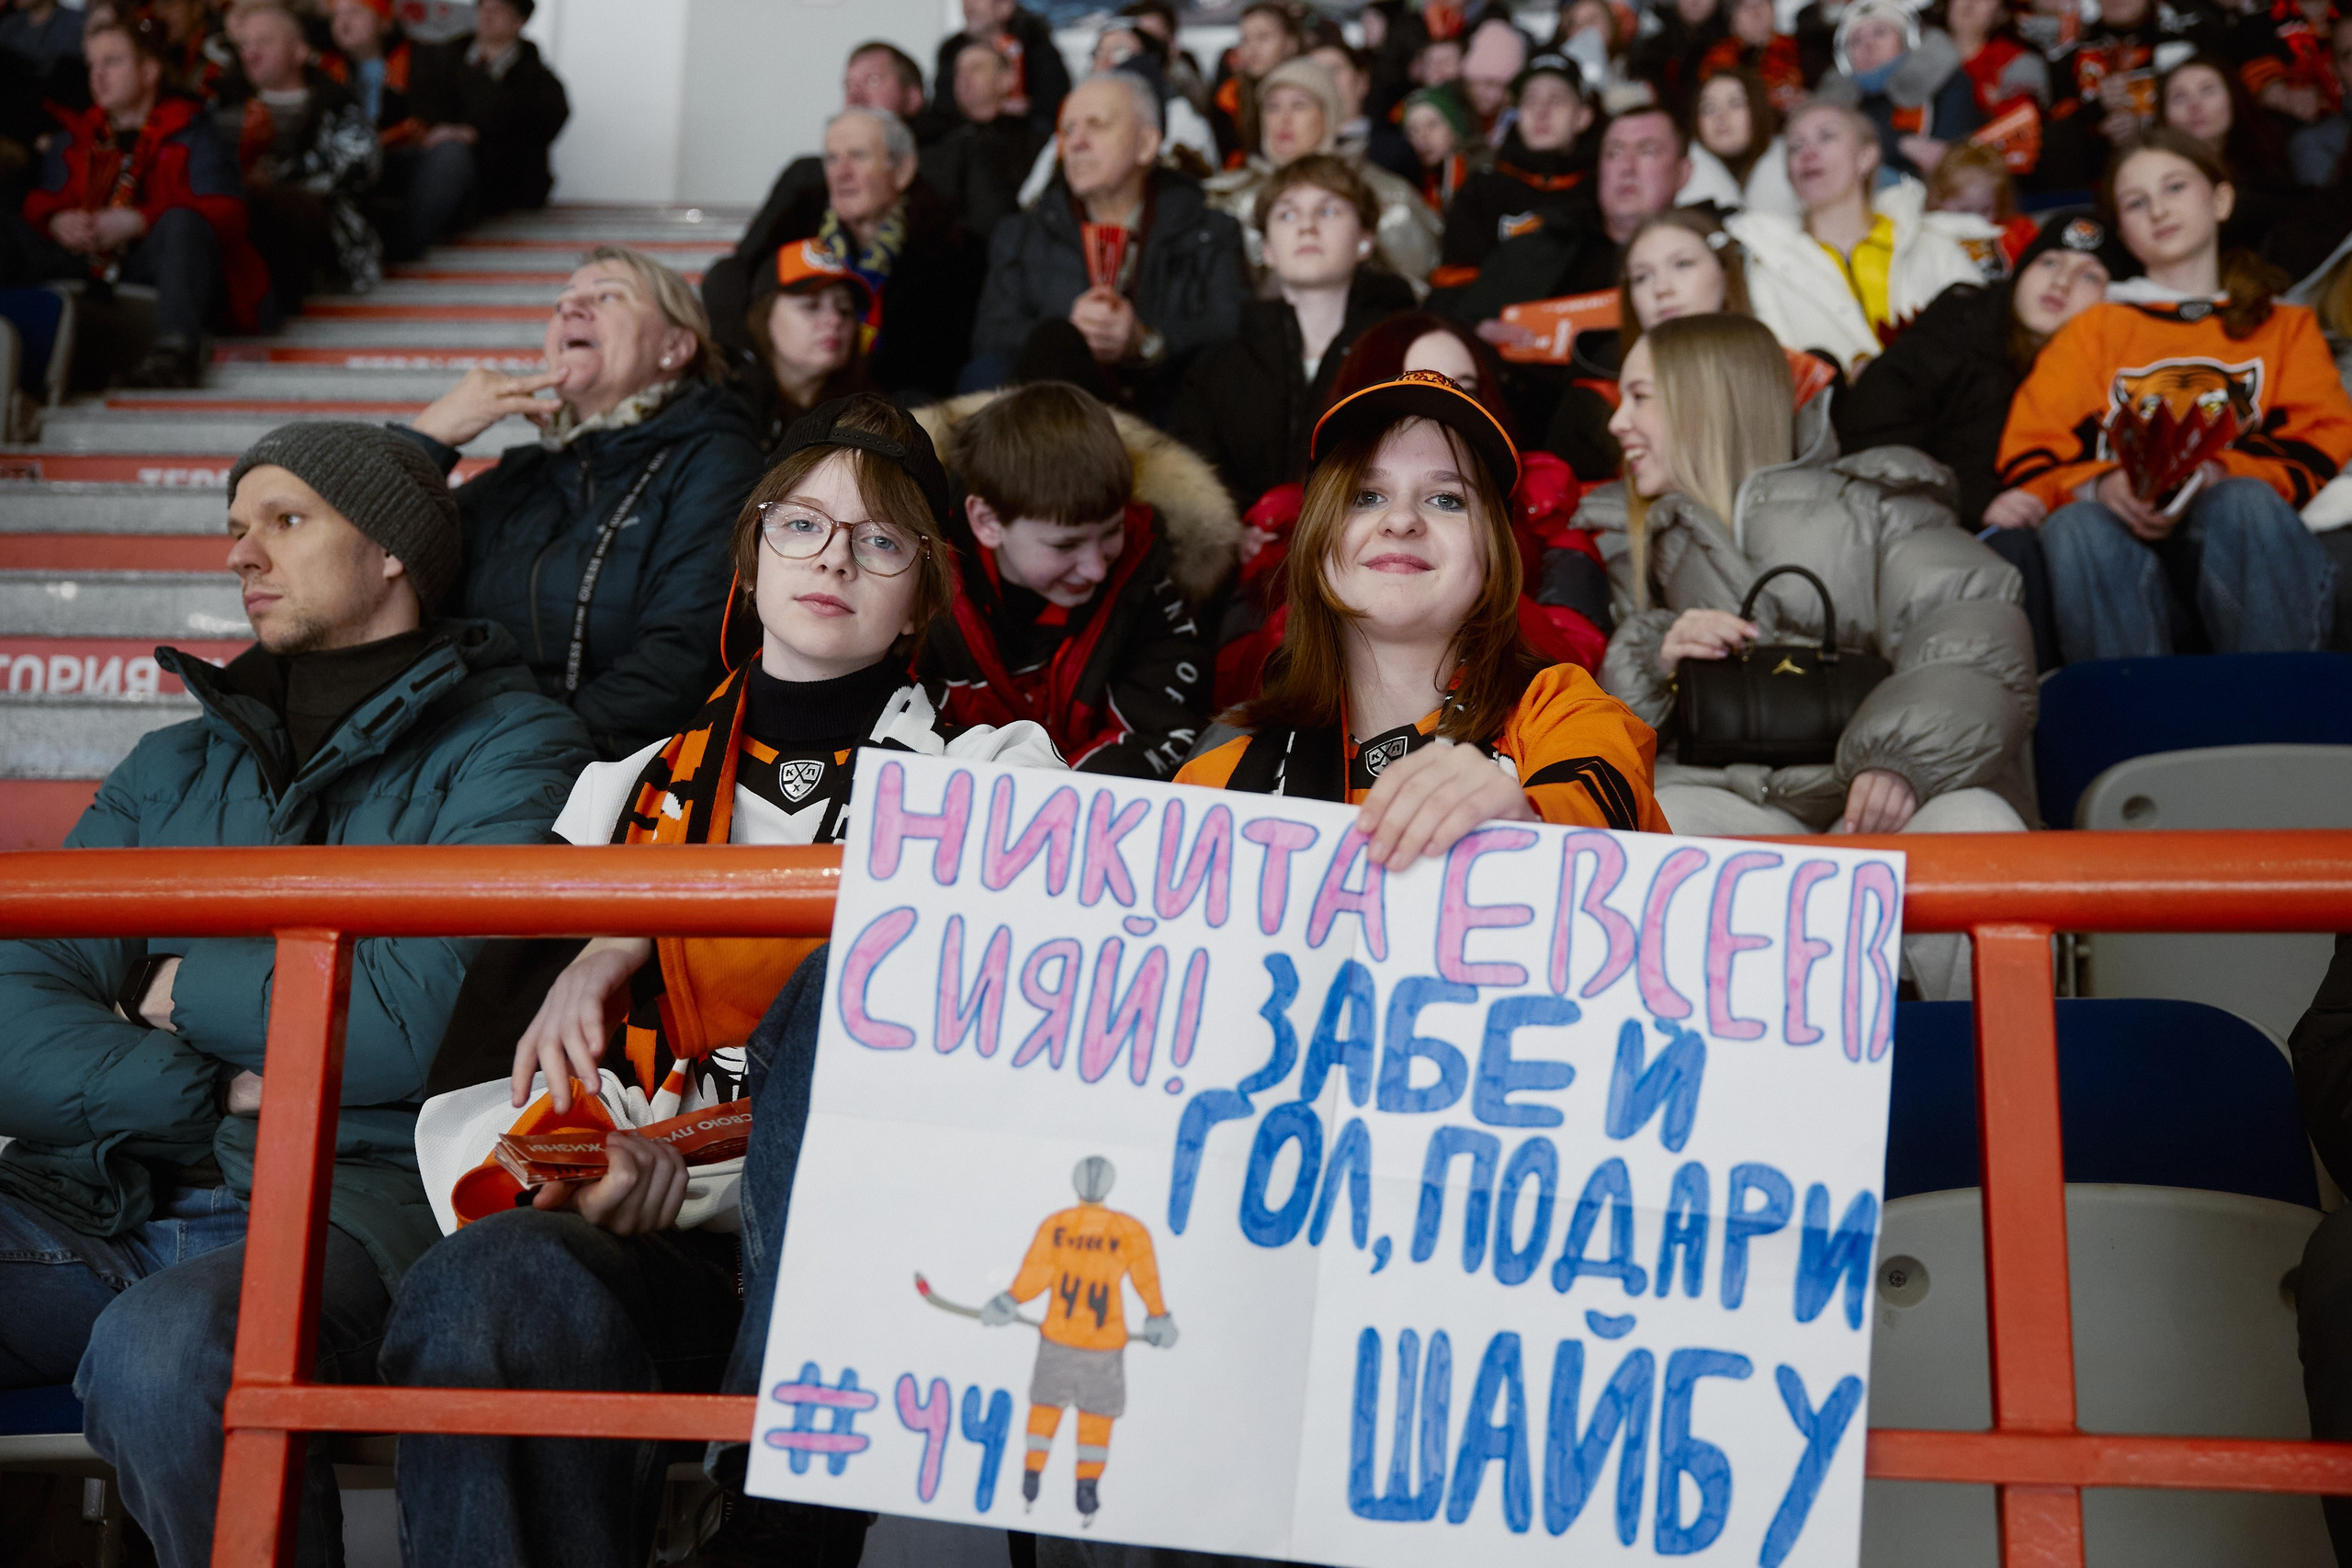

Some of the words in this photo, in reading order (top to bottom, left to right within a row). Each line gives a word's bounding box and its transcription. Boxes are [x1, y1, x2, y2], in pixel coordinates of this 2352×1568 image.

[838, 905, 1210, 1095] СИЯЙ!
[868, 760, 1388, 963] НИКИТА
[1435, 827, 1899, 1063] ЕВСЕЕВ
[696, 1112, 753, 1131] СВОЮ
[1236, 952, 1707, 1154] ЗАБЕЙ
[1060, 1269, 1109, 1330] 44
[1168, 1087, 1394, 1276] ГОЛ,
[1409, 1124, 1877, 1331] ПОДАРИ
[1347, 1308, 1863, 1568] ШАЙБУ
